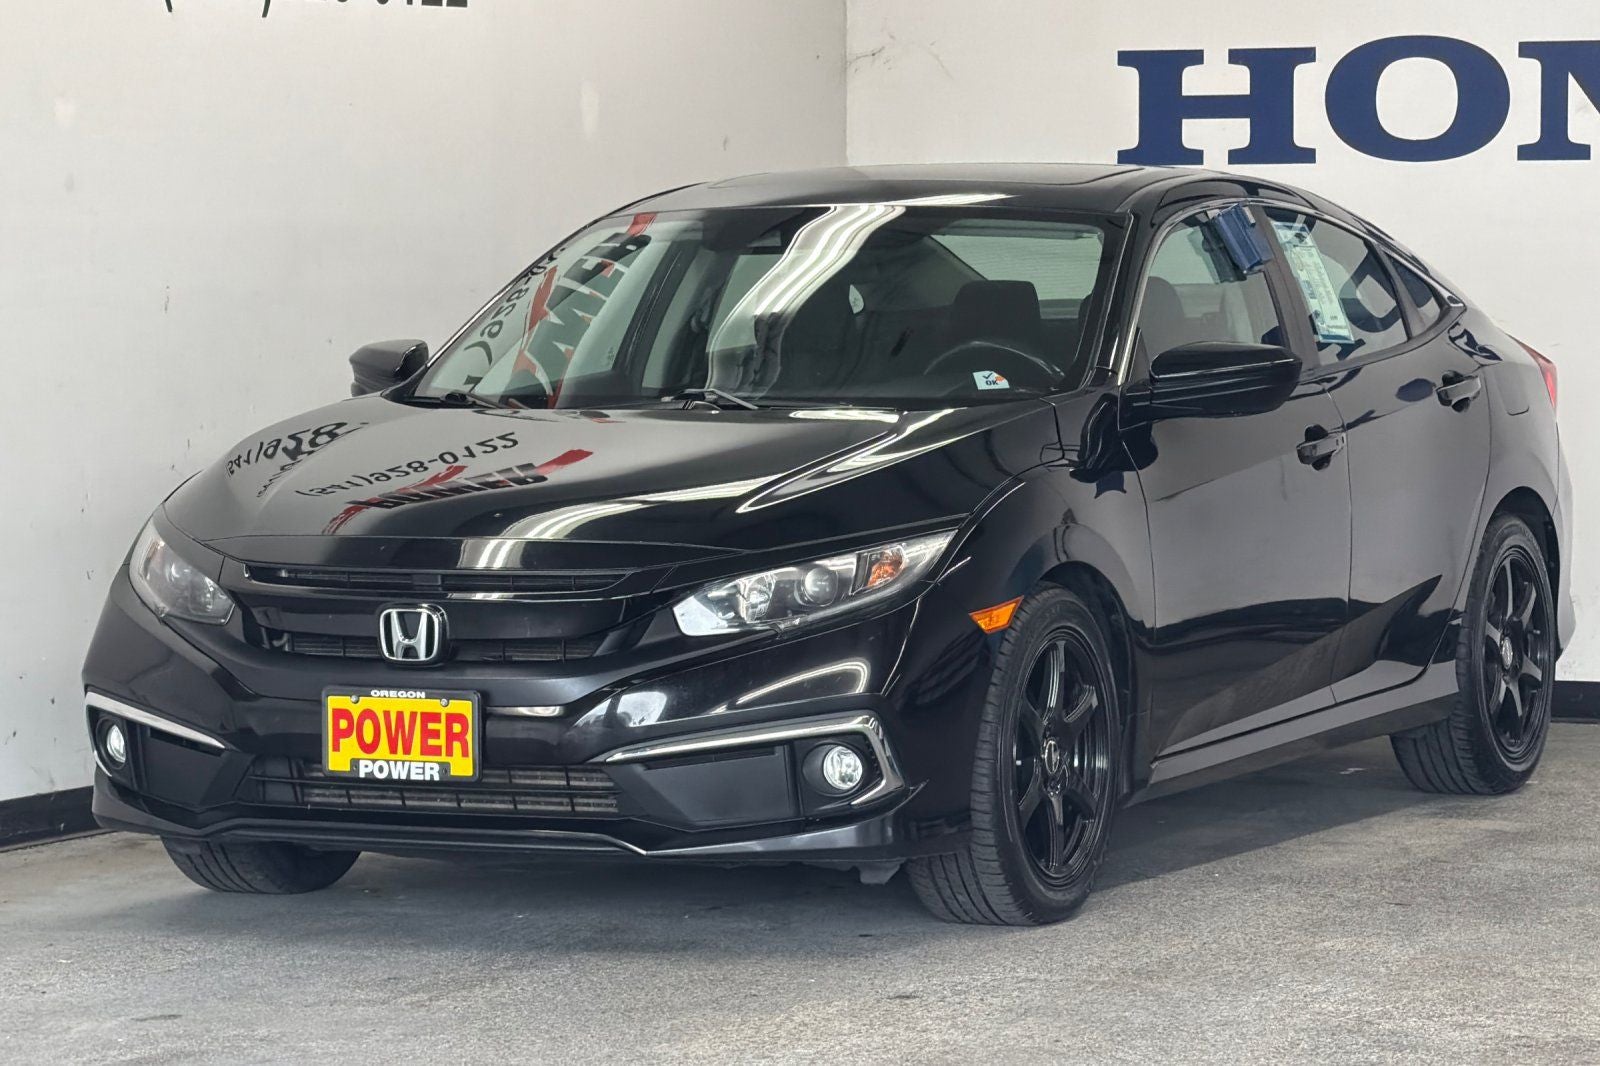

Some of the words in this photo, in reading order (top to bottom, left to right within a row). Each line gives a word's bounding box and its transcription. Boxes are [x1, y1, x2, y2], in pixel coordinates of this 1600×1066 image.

[370, 689, 426, 699] OREGON
[331, 708, 470, 758] POWER
[358, 759, 440, 781] POWER
